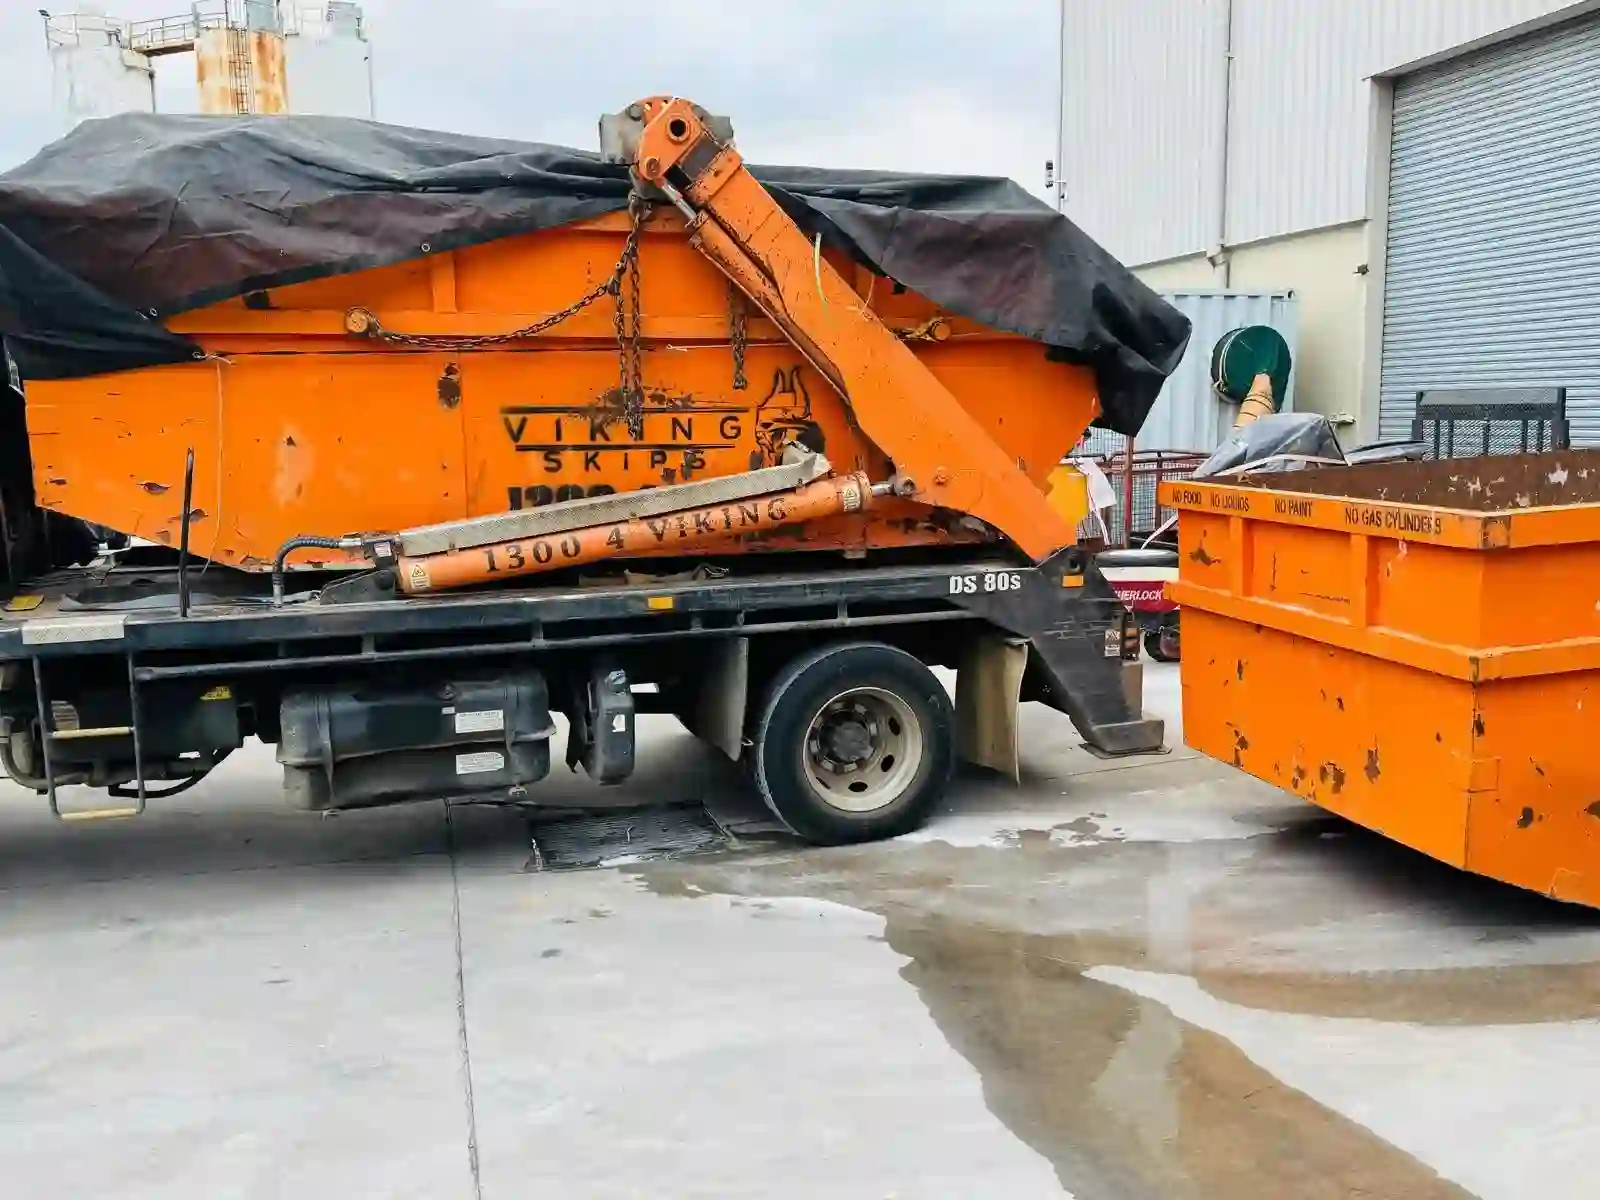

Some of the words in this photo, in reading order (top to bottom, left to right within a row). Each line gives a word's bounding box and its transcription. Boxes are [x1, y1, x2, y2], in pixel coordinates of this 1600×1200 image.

[503, 415, 743, 443] VIKING
[1172, 488, 1182, 503] NO
[1184, 490, 1202, 504] FOOD
[1210, 491, 1220, 508] NO
[1275, 499, 1286, 513] NO
[1289, 499, 1313, 518] PAINT
[1345, 507, 1358, 525] NO
[1361, 509, 1381, 527] GAS
[484, 536, 582, 573] 1300
[606, 527, 624, 549] 4
[647, 497, 788, 541] VIKING
[950, 574, 977, 594] DS
